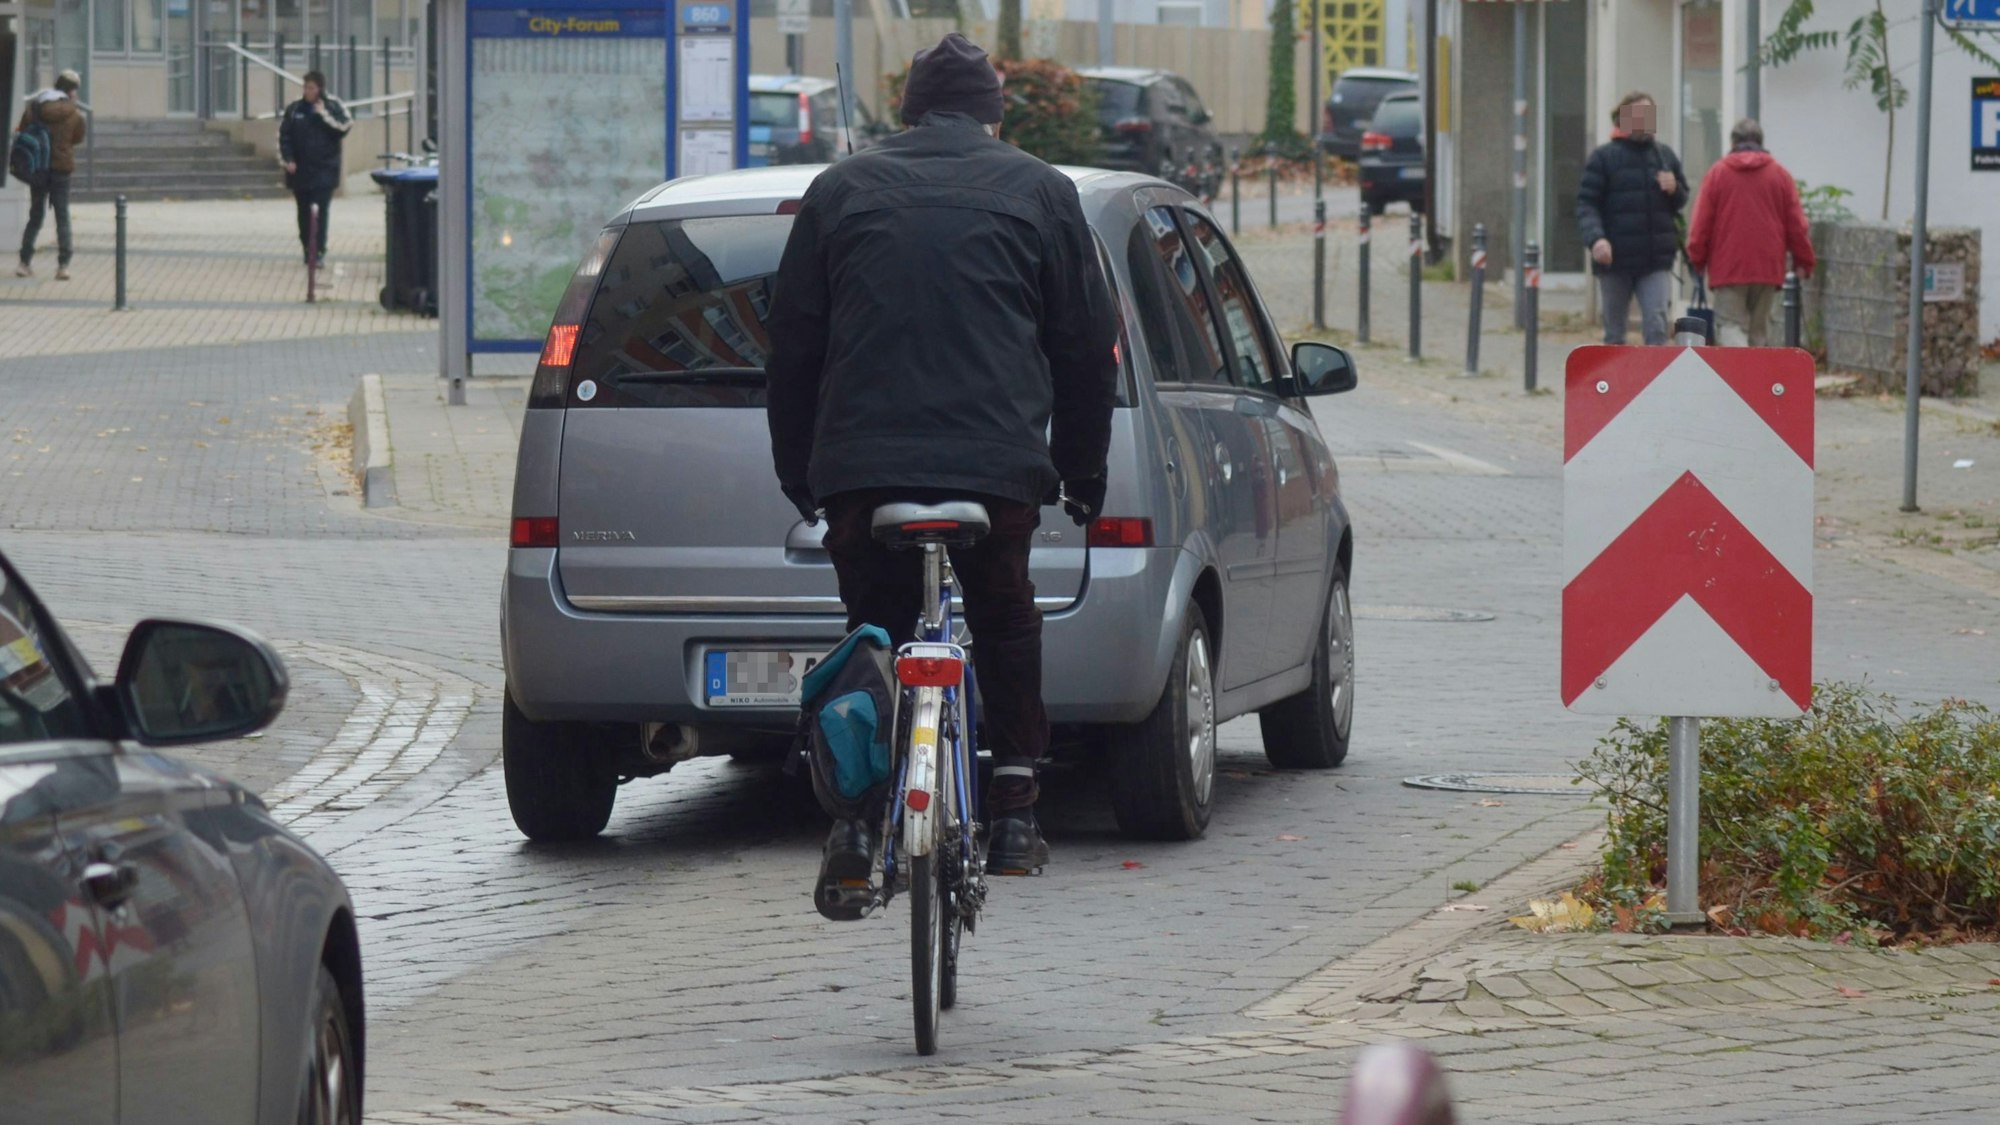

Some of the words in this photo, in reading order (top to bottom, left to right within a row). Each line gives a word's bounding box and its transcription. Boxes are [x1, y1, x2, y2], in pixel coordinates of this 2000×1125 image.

[691, 6, 720, 22] 860
[528, 16, 620, 35] City-Forum
[573, 530, 636, 541] MERIVA
[712, 678, 721, 690] D
